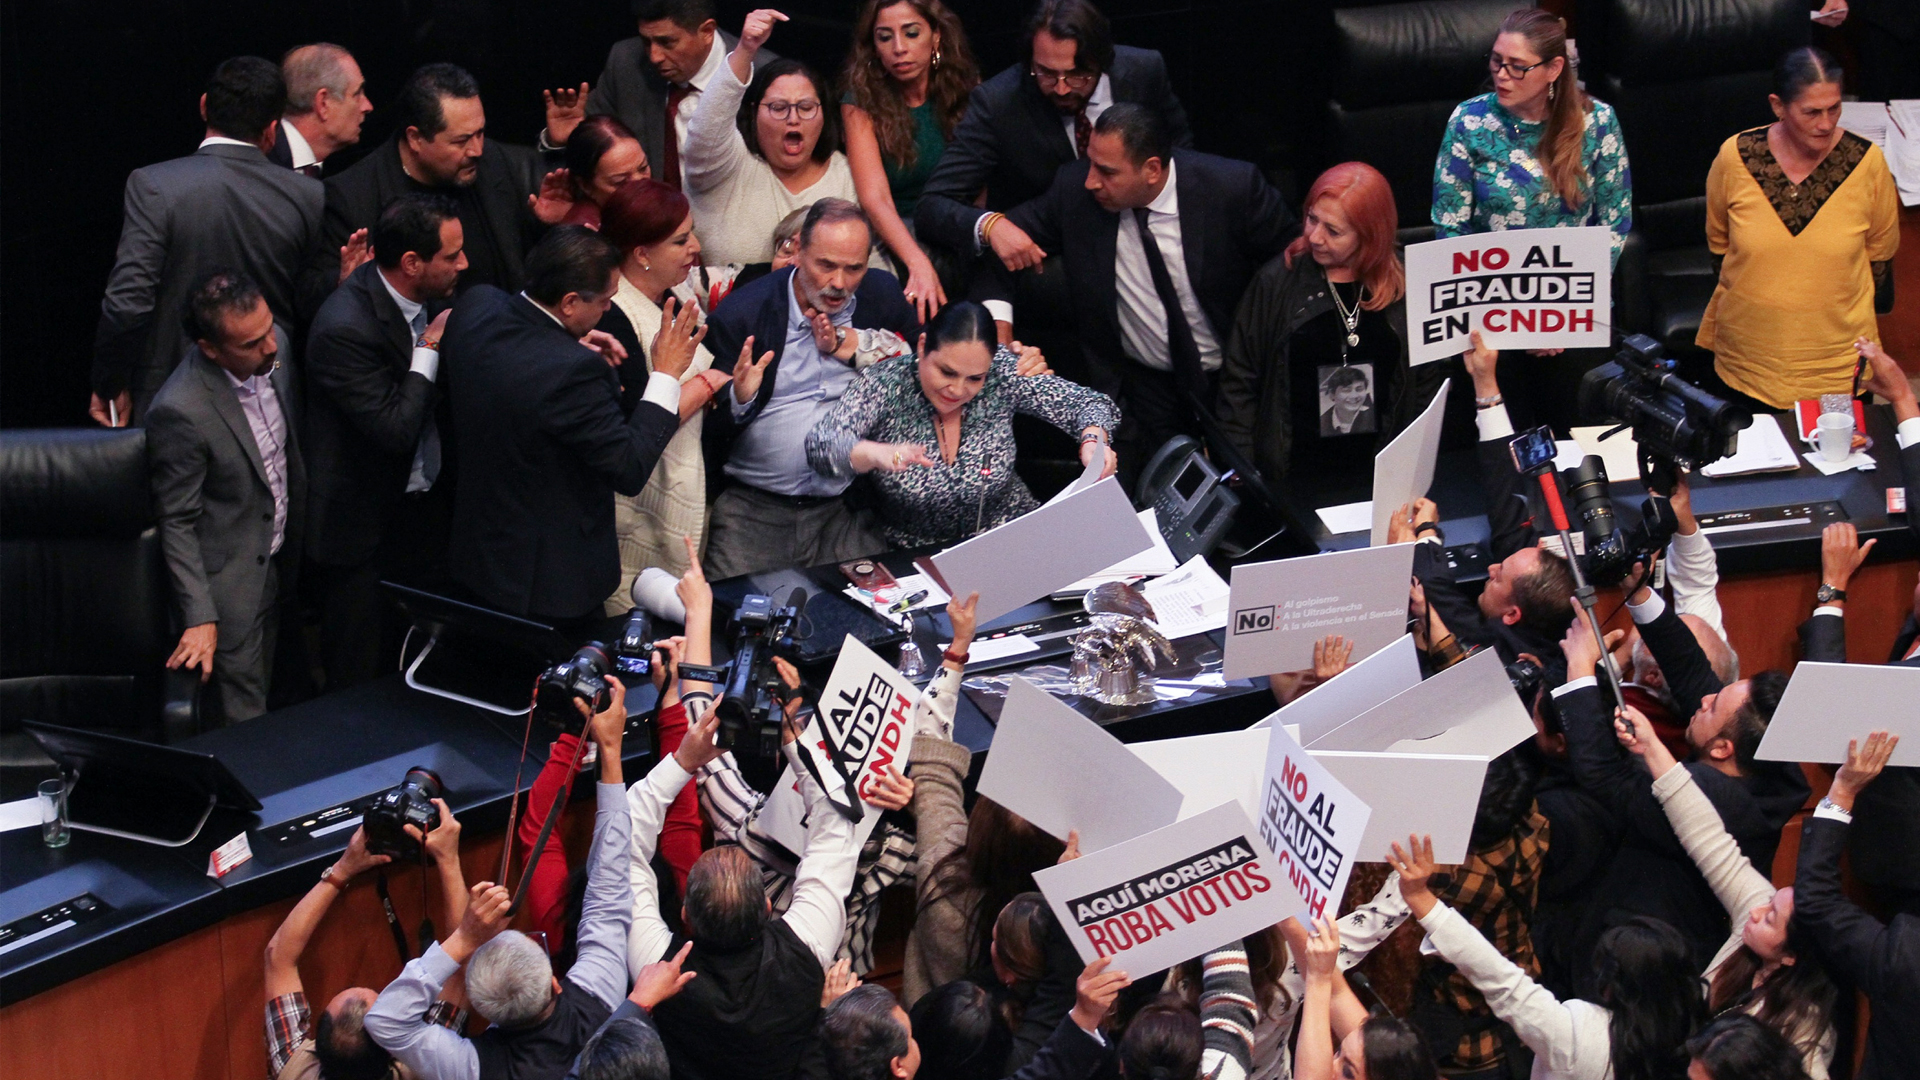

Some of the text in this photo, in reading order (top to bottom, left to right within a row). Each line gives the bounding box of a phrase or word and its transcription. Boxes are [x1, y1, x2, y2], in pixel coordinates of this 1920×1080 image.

[1452, 245, 1573, 275] NO AL
[1433, 275, 1593, 311] FRAUDE
[1422, 308, 1594, 346] EN CNDH
[1295, 595, 1339, 609] golpismo
[1301, 616, 1343, 630] violencia
[1344, 614, 1357, 623] en
[1358, 611, 1368, 621] el
[1369, 607, 1405, 620] Senado
[1303, 602, 1363, 618] Ultraderecha
[1238, 612, 1271, 631] No
[829, 686, 863, 737] AL
[1280, 753, 1336, 838] NO AL
[1267, 781, 1341, 887] FRAUDE
[1076, 844, 1253, 923] AQUÍ MORENA
[1083, 860, 1272, 959] ROBA VOTOS
